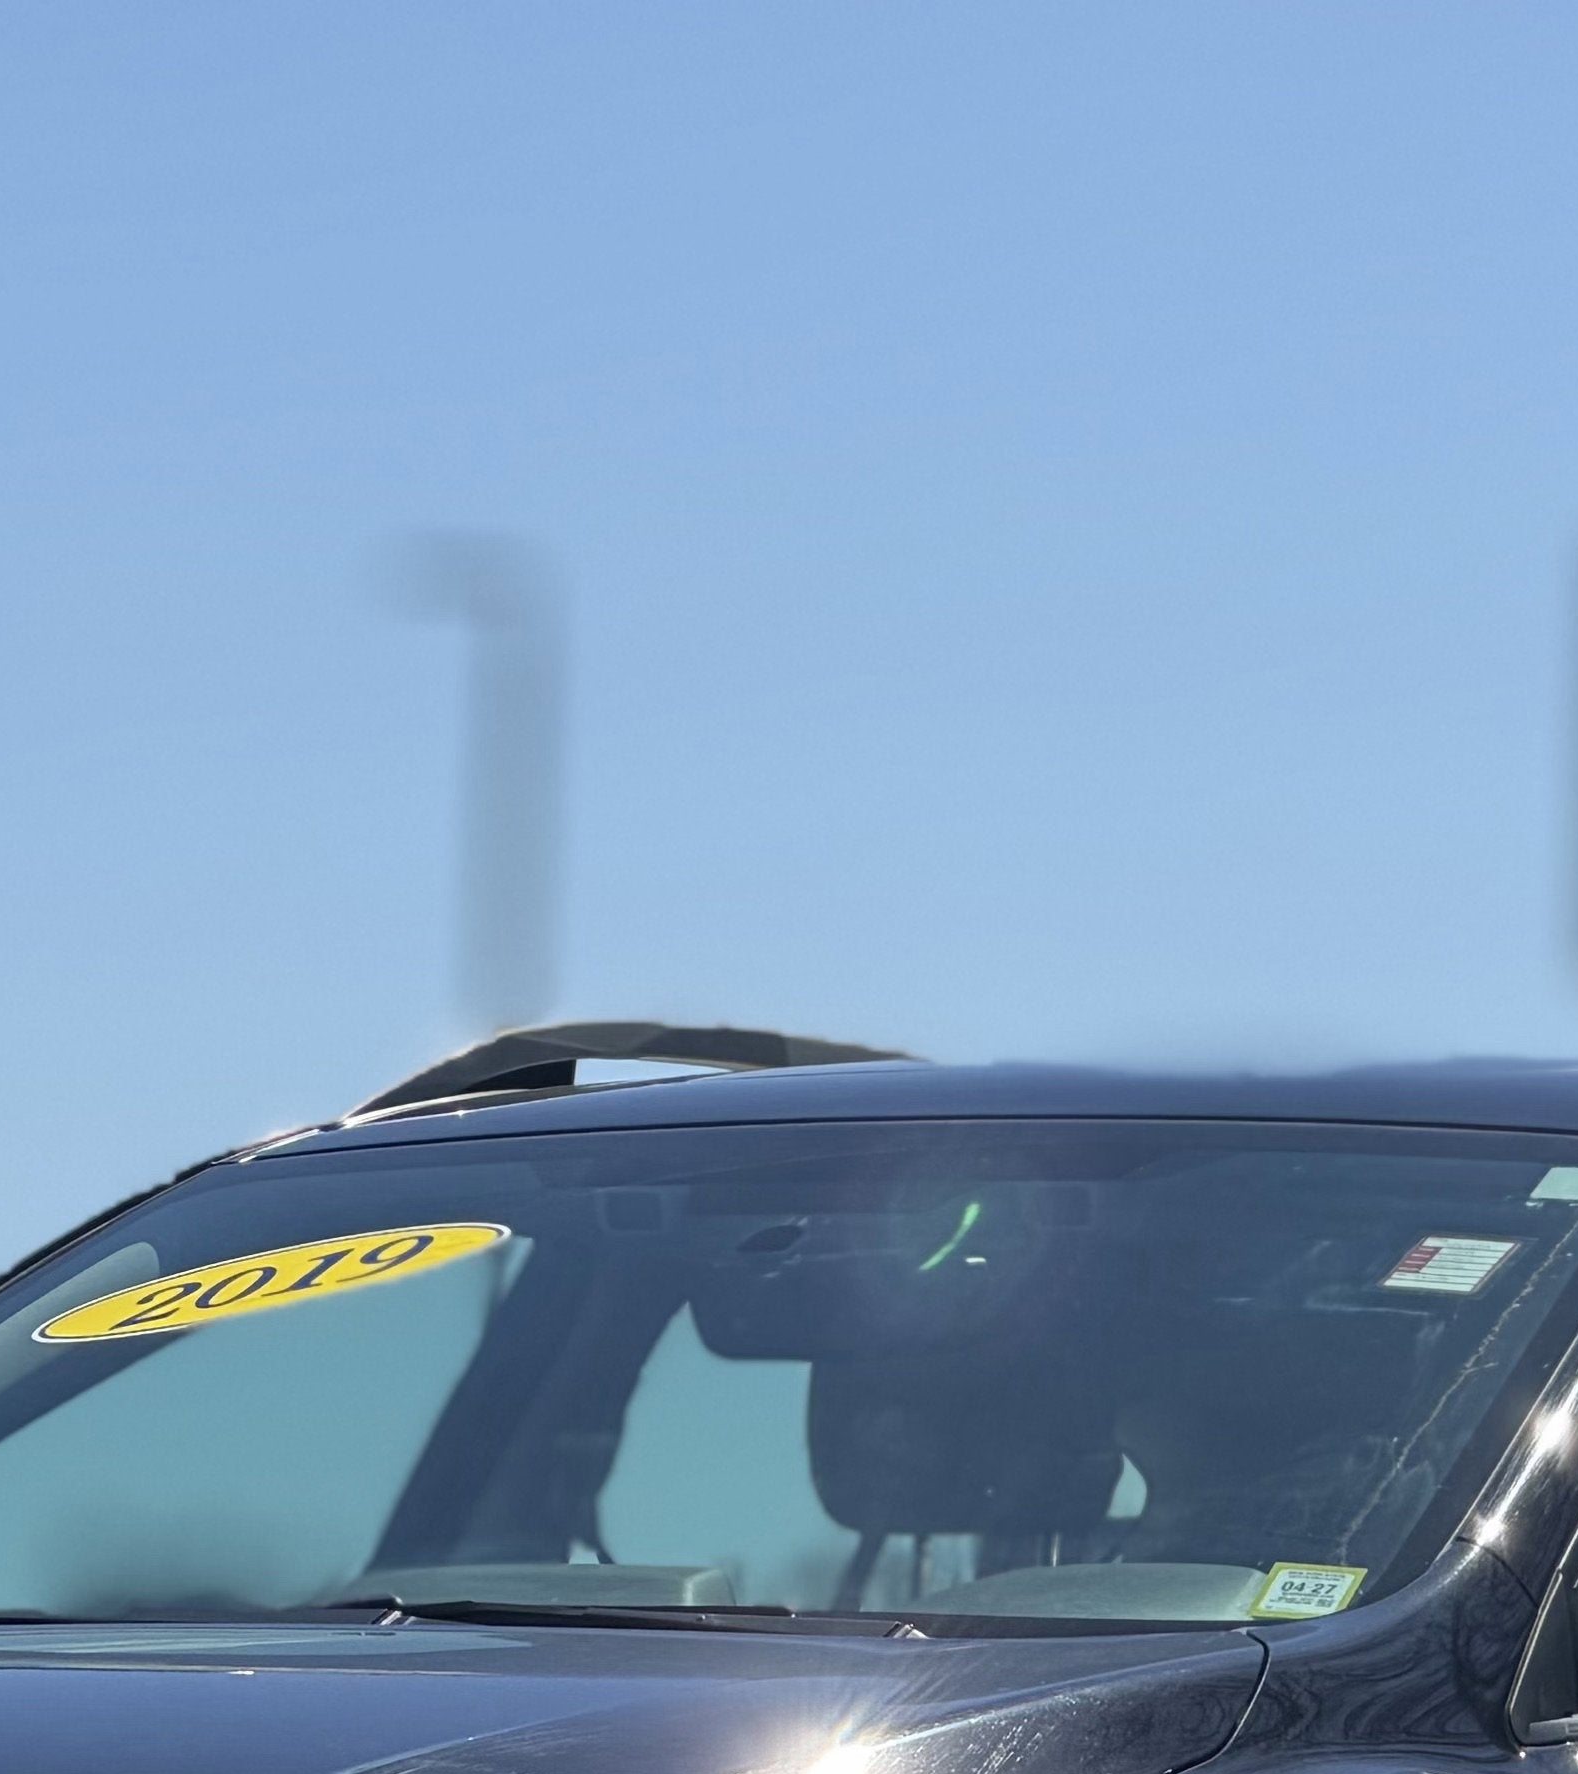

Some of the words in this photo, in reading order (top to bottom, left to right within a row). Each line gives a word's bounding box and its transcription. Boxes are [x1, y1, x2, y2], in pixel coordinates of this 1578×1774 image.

[108, 1234, 434, 1331] 2019
[1281, 1580, 1305, 1593] 04
[1311, 1582, 1338, 1595] 27
